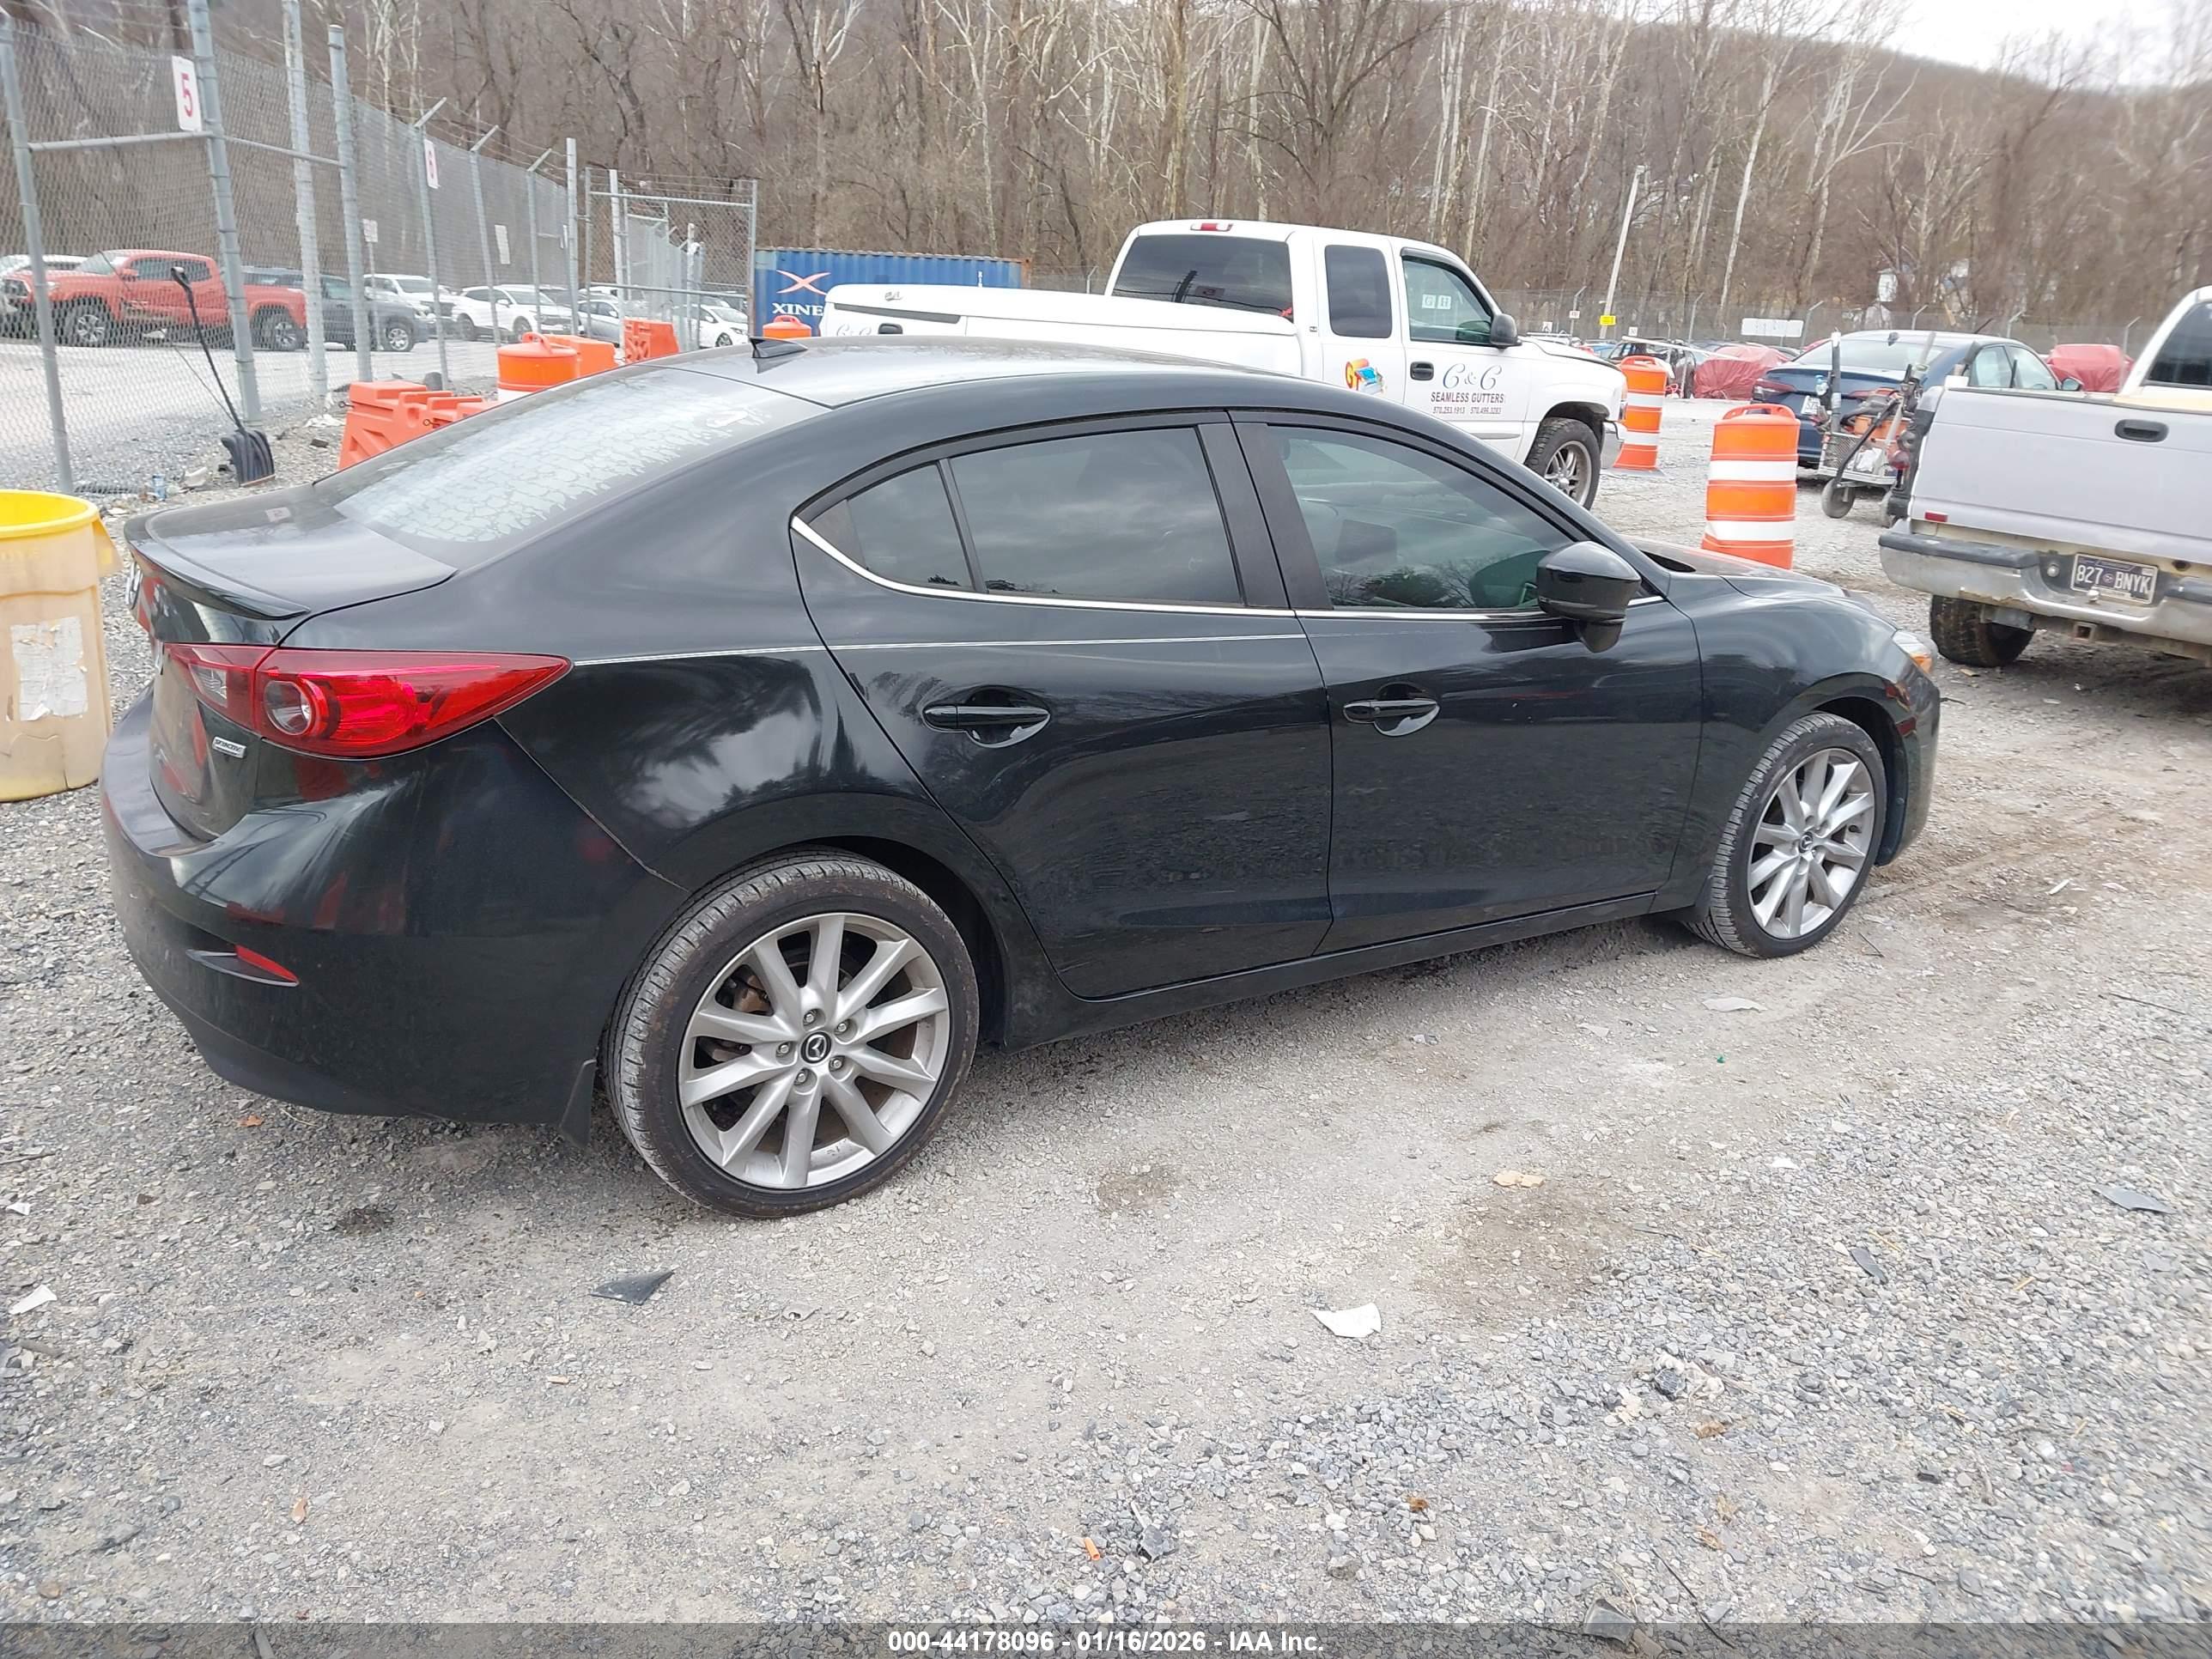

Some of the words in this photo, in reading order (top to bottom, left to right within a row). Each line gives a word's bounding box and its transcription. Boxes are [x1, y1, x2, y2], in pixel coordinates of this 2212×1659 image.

[181, 72, 194, 118] 5
[1431, 392, 1469, 403] SEAMLESS
[1471, 393, 1504, 404] GUTTERS
[2076, 564, 2104, 585] 827
[2113, 571, 2151, 595] BNYK
